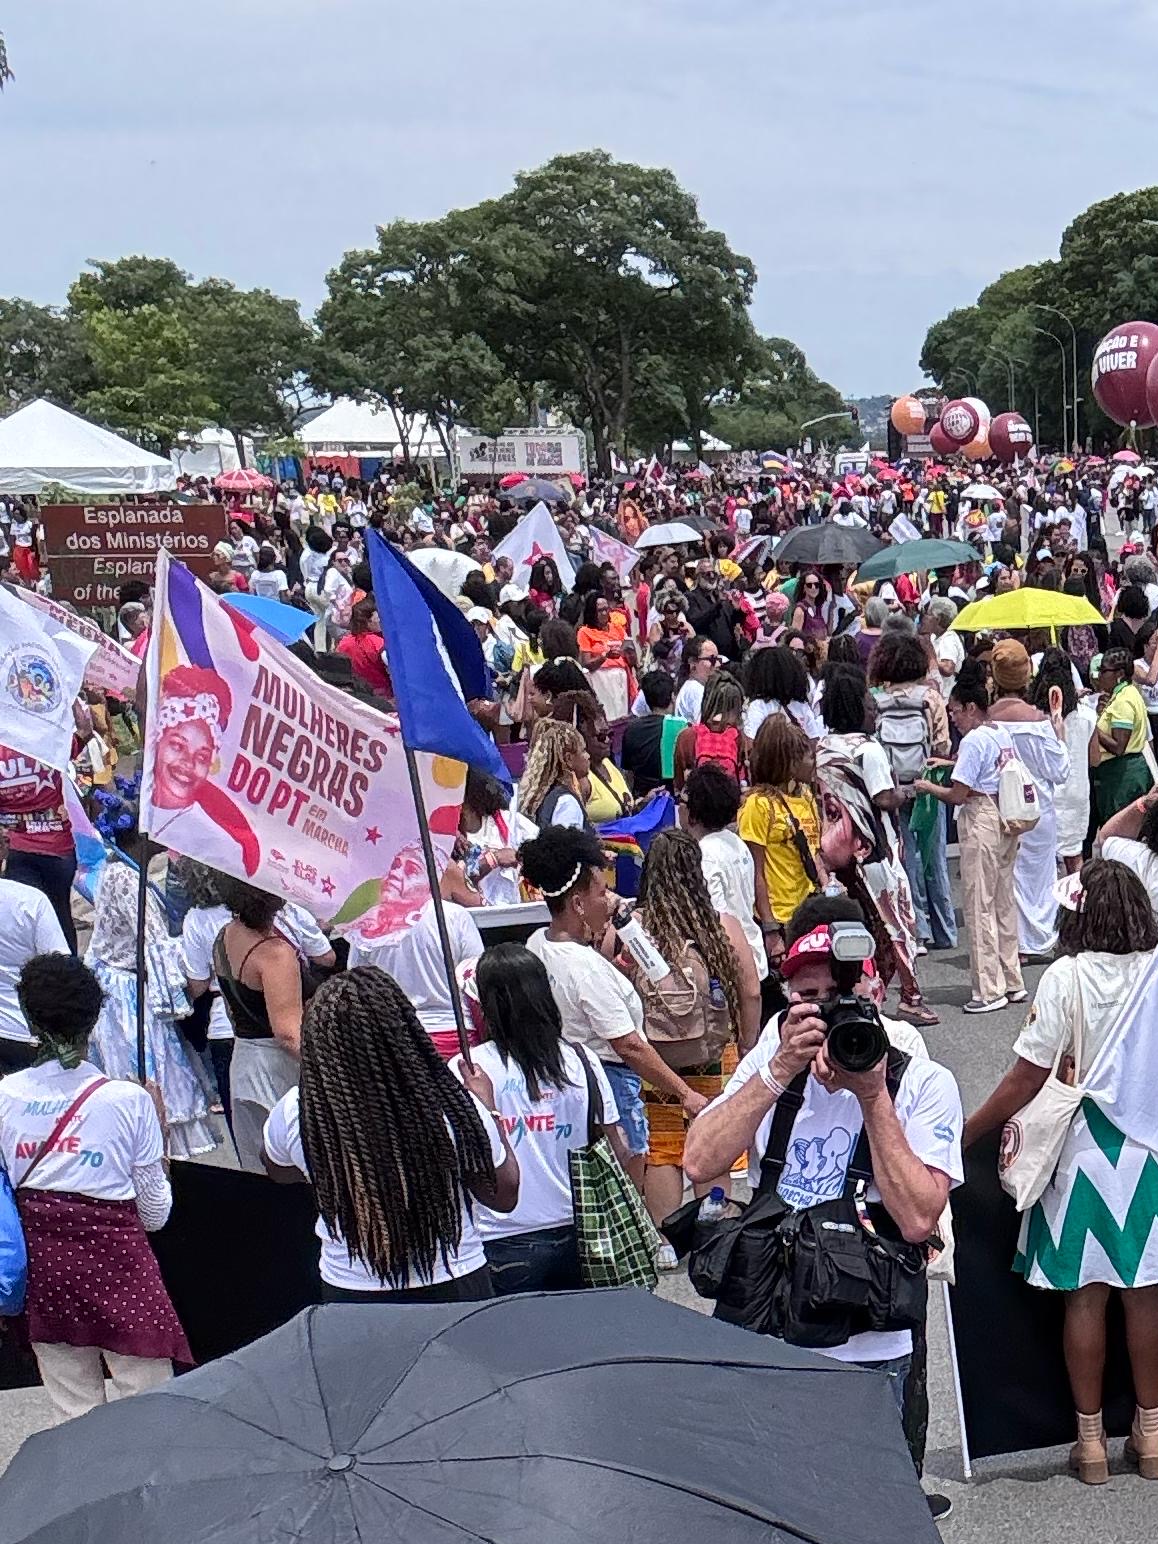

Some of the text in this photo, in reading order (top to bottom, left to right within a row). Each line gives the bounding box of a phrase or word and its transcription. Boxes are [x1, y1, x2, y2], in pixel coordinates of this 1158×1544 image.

[84, 507, 184, 528] Esplanada
[66, 531, 209, 550] dos Ministérios
[94, 558, 158, 577] Esplan
[74, 584, 93, 600] of
[252, 664, 387, 773] MULHERES
[240, 703, 369, 818] NEGRAS
[227, 752, 311, 827] DO PT
[301, 818, 349, 858] MARCHA
[503, 1114, 556, 1142] VANTE
[555, 1123, 573, 1140] 70
[79, 1150, 104, 1168] 70
